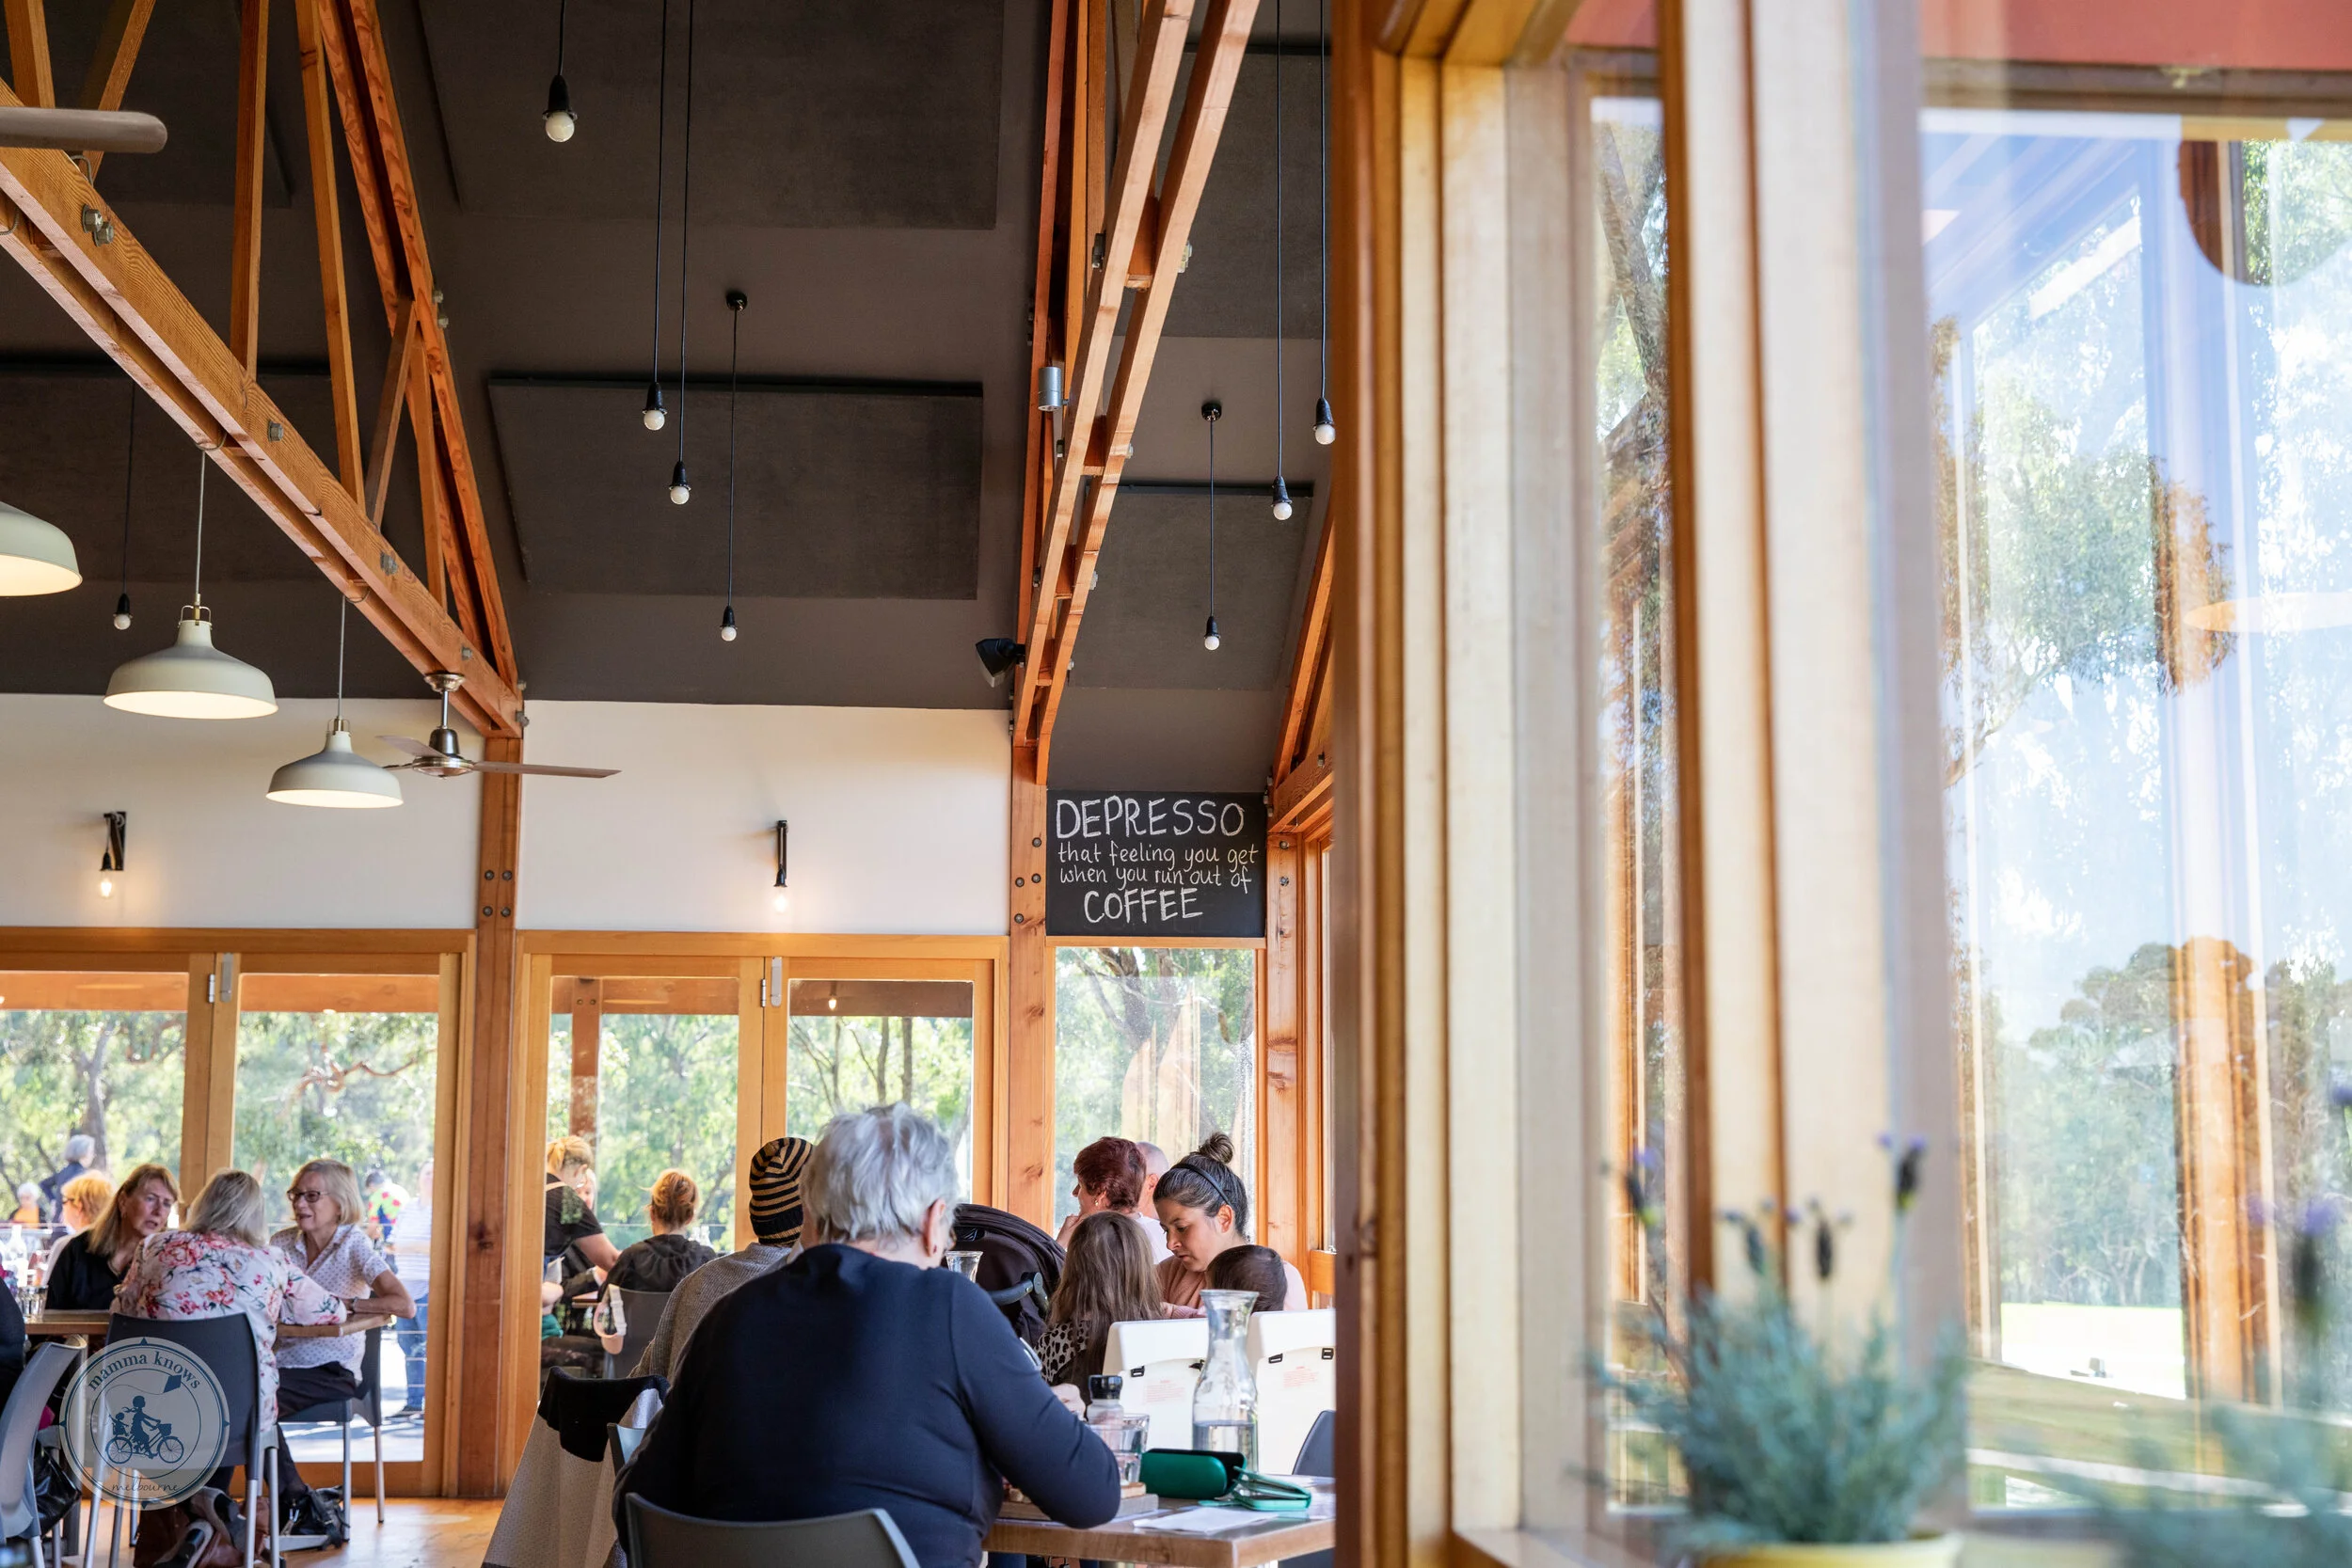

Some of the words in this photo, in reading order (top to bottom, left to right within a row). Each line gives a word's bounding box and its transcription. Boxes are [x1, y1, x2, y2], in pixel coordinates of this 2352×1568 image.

[1056, 795, 1245, 838] DEPRESSO
[1058, 841, 1102, 863] that
[1109, 840, 1175, 872] feeling
[1184, 847, 1220, 872] you
[1227, 844, 1259, 872] get
[1060, 865, 1107, 883] when
[1116, 867, 1148, 891] you
[1155, 870, 1184, 884] run
[1190, 865, 1221, 886] out
[1231, 865, 1252, 894] of
[1084, 888, 1203, 924] COFFEE
